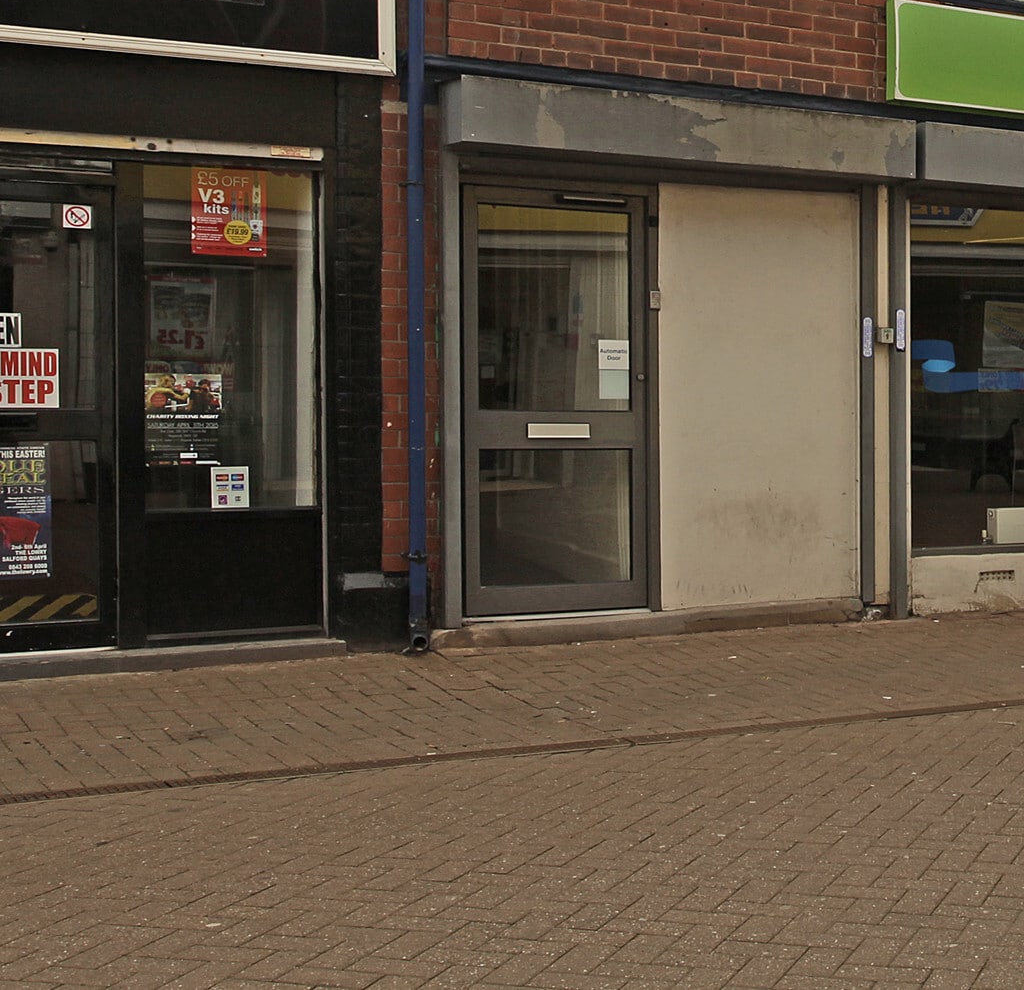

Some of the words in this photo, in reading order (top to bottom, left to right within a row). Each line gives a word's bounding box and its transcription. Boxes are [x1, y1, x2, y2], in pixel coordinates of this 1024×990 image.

[197, 170, 219, 186] £5
[221, 175, 249, 187] OFF
[198, 188, 225, 204] V3
[203, 203, 230, 215] kits
[226, 228, 249, 236] £19.99
[0, 351, 57, 377] MIND
[0, 379, 54, 404] TEP
[15, 450, 46, 458] EASTER!
